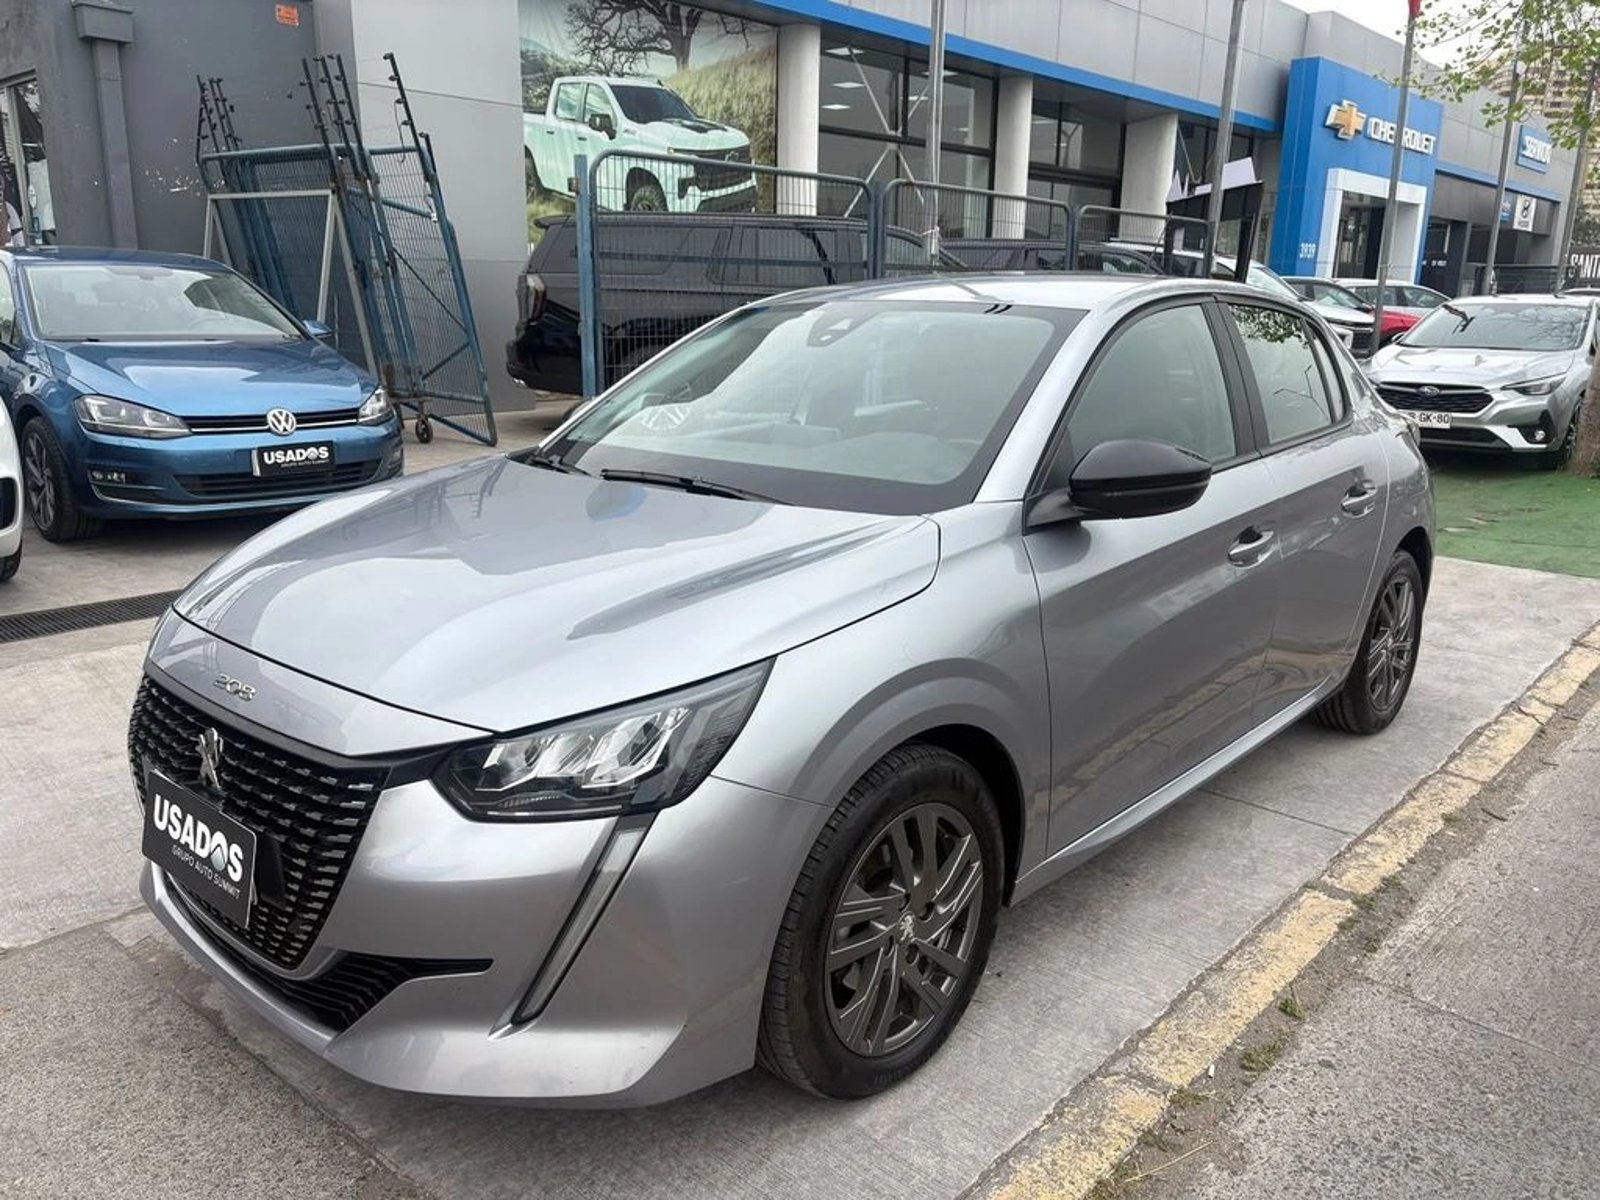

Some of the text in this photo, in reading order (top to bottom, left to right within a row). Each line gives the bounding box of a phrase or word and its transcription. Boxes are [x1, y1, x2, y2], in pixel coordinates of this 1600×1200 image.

[1367, 117, 1436, 154] CHEROLET
[263, 446, 329, 464] USADOS
[213, 672, 256, 701] 208
[153, 793, 243, 882] USADOS
[195, 860, 213, 880] AUTO
